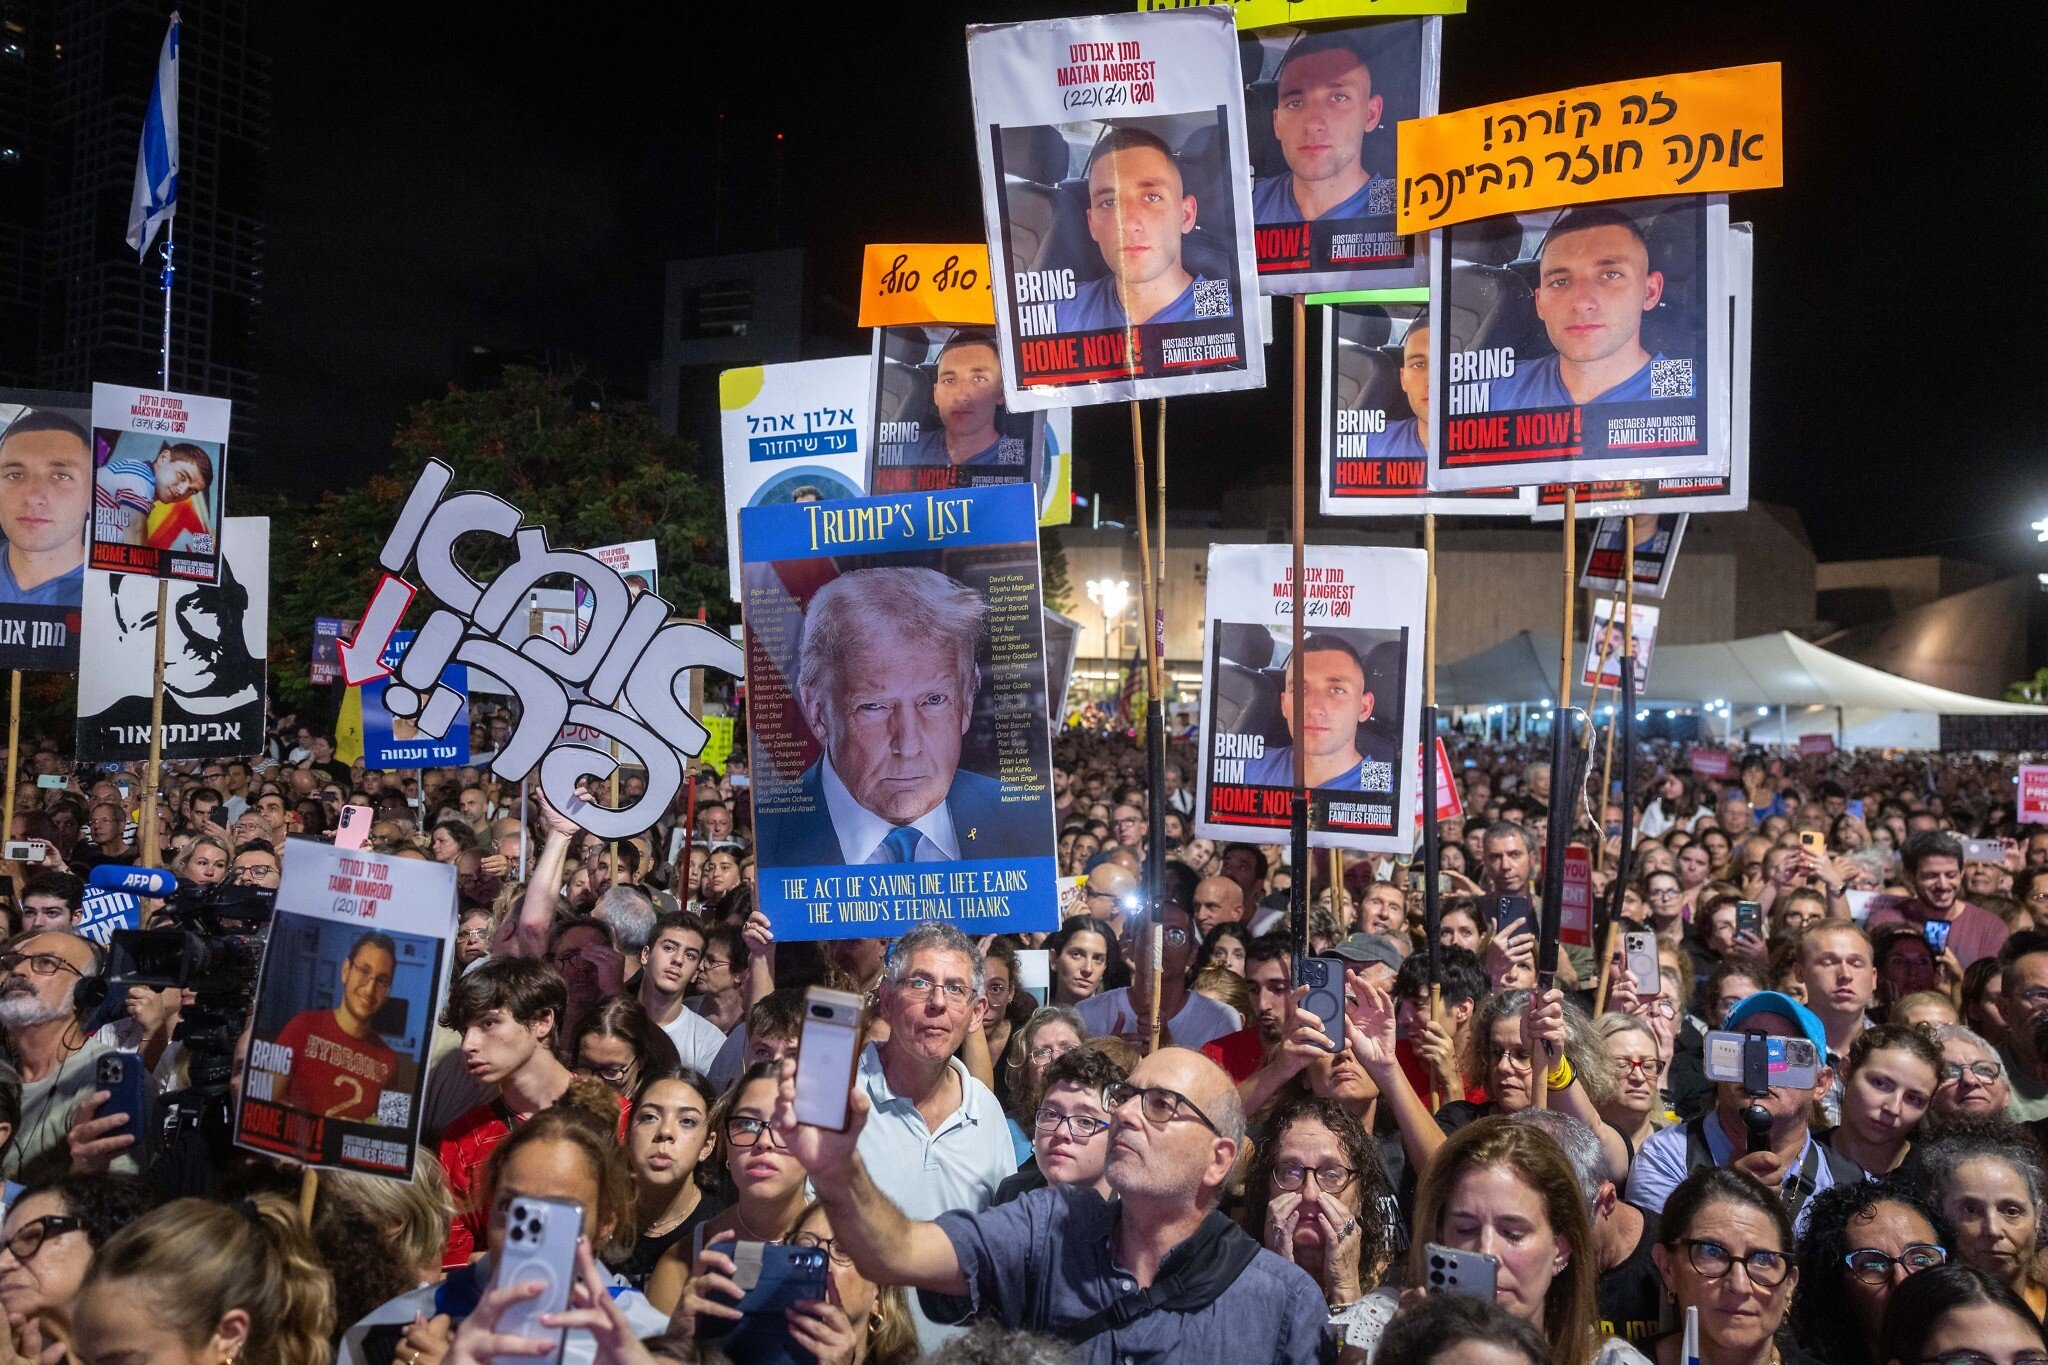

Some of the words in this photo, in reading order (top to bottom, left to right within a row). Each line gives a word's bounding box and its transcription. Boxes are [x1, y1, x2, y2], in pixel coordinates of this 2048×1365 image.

[1070, 44, 1114, 63] אנגרסט
[1117, 41, 1140, 60] מתן
[1057, 65, 1099, 86] MATAN
[1103, 61, 1156, 82] ANGREST
[1620, 91, 1677, 125] זה
[1545, 139, 1642, 185] חוזר
[1663, 129, 1763, 185] אתה
[1255, 223, 1309, 259] NOW!
[1332, 234, 1363, 244] HOSTAGES
[1364, 233, 1376, 242] AND
[1332, 244, 1371, 259] FAMILIES
[1373, 241, 1404, 256] FORUM
[1015, 269, 1076, 303] BRING
[1017, 304, 1057, 336] HIM
[1021, 338, 1079, 372] HOME
[1083, 328, 1142, 368] NOW!
[1162, 337, 1192, 349] HOSTAGES
[1193, 336, 1206, 347] AND
[1207, 333, 1235, 345] MISSING
[1163, 346, 1202, 364] FAMILIES
[1204, 343, 1236, 360] FORUM
[1450, 347, 1515, 383] BRING
[1449, 383, 1490, 415] HIM
[131, 405, 161, 418] MAKSYM
[163, 409, 188, 421] HARKIN
[747, 412, 795, 434] אהל
[804, 407, 855, 431] אלון
[1337, 410, 1385, 432] BRING
[1608, 418, 1645, 430] HOSTAGES
[1647, 417, 1662, 428] AND
[1663, 416, 1695, 427] MISSING
[880, 422, 920, 442] BRING
[1450, 417, 1508, 450] HOME
[1516, 408, 1581, 446] NOW!
[1608, 429, 1656, 445] FAMILIES
[1658, 426, 1696, 442] FORUM
[760, 437, 818, 456] שיחזור
[824, 434, 847, 450] עד
[1337, 435, 1366, 458] HIM
[878, 445, 904, 465] HIM
[1336, 462, 1381, 484] HOME
[1386, 462, 1425, 484] NOW
[96, 508, 130, 527] BRING
[95, 524, 117, 542] HIM
[94, 544, 126, 563] HOME
[129, 547, 159, 568] NOW!
[171, 564, 195, 574] FAMILIES
[196, 567, 214, 577] FORUM
[1326, 569, 1343, 584] מתן
[1310, 585, 1355, 599] ANGREST
[32, 621, 66, 648] מתן
[110, 726, 152, 744] אור
[160, 722, 241, 749] אבינתן
[1215, 732, 1264, 760] BRING
[432, 747, 457, 758] עוז
[1213, 758, 1245, 784] HIM
[1212, 787, 1259, 812] HOME
[1329, 802, 1356, 810] HOSTAGES
[1357, 803, 1367, 812] AND
[1368, 805, 1391, 813] MISSING
[1328, 810, 1362, 823] FAMILIES
[1364, 812, 1391, 825] FORUM
[122, 874, 149, 887] AFP
[367, 863, 388, 880] תמיר
[328, 875, 352, 894] TAMIR
[354, 880, 392, 900] NIMRODI
[782, 878, 808, 900] THE
[814, 876, 843, 898] ACT
[847, 876, 864, 896] OF
[870, 874, 916, 897] SAVING
[920, 873, 944, 894] ONE
[950, 872, 978, 893] LIFE
[983, 870, 1028, 892] EARNS
[806, 902, 832, 924] THE
[838, 900, 890, 922] WORLD'S
[895, 898, 954, 920] ETERNAL
[958, 896, 1010, 918] THANKS
[250, 1039, 293, 1075] BRING
[247, 1069, 274, 1101] HIM
